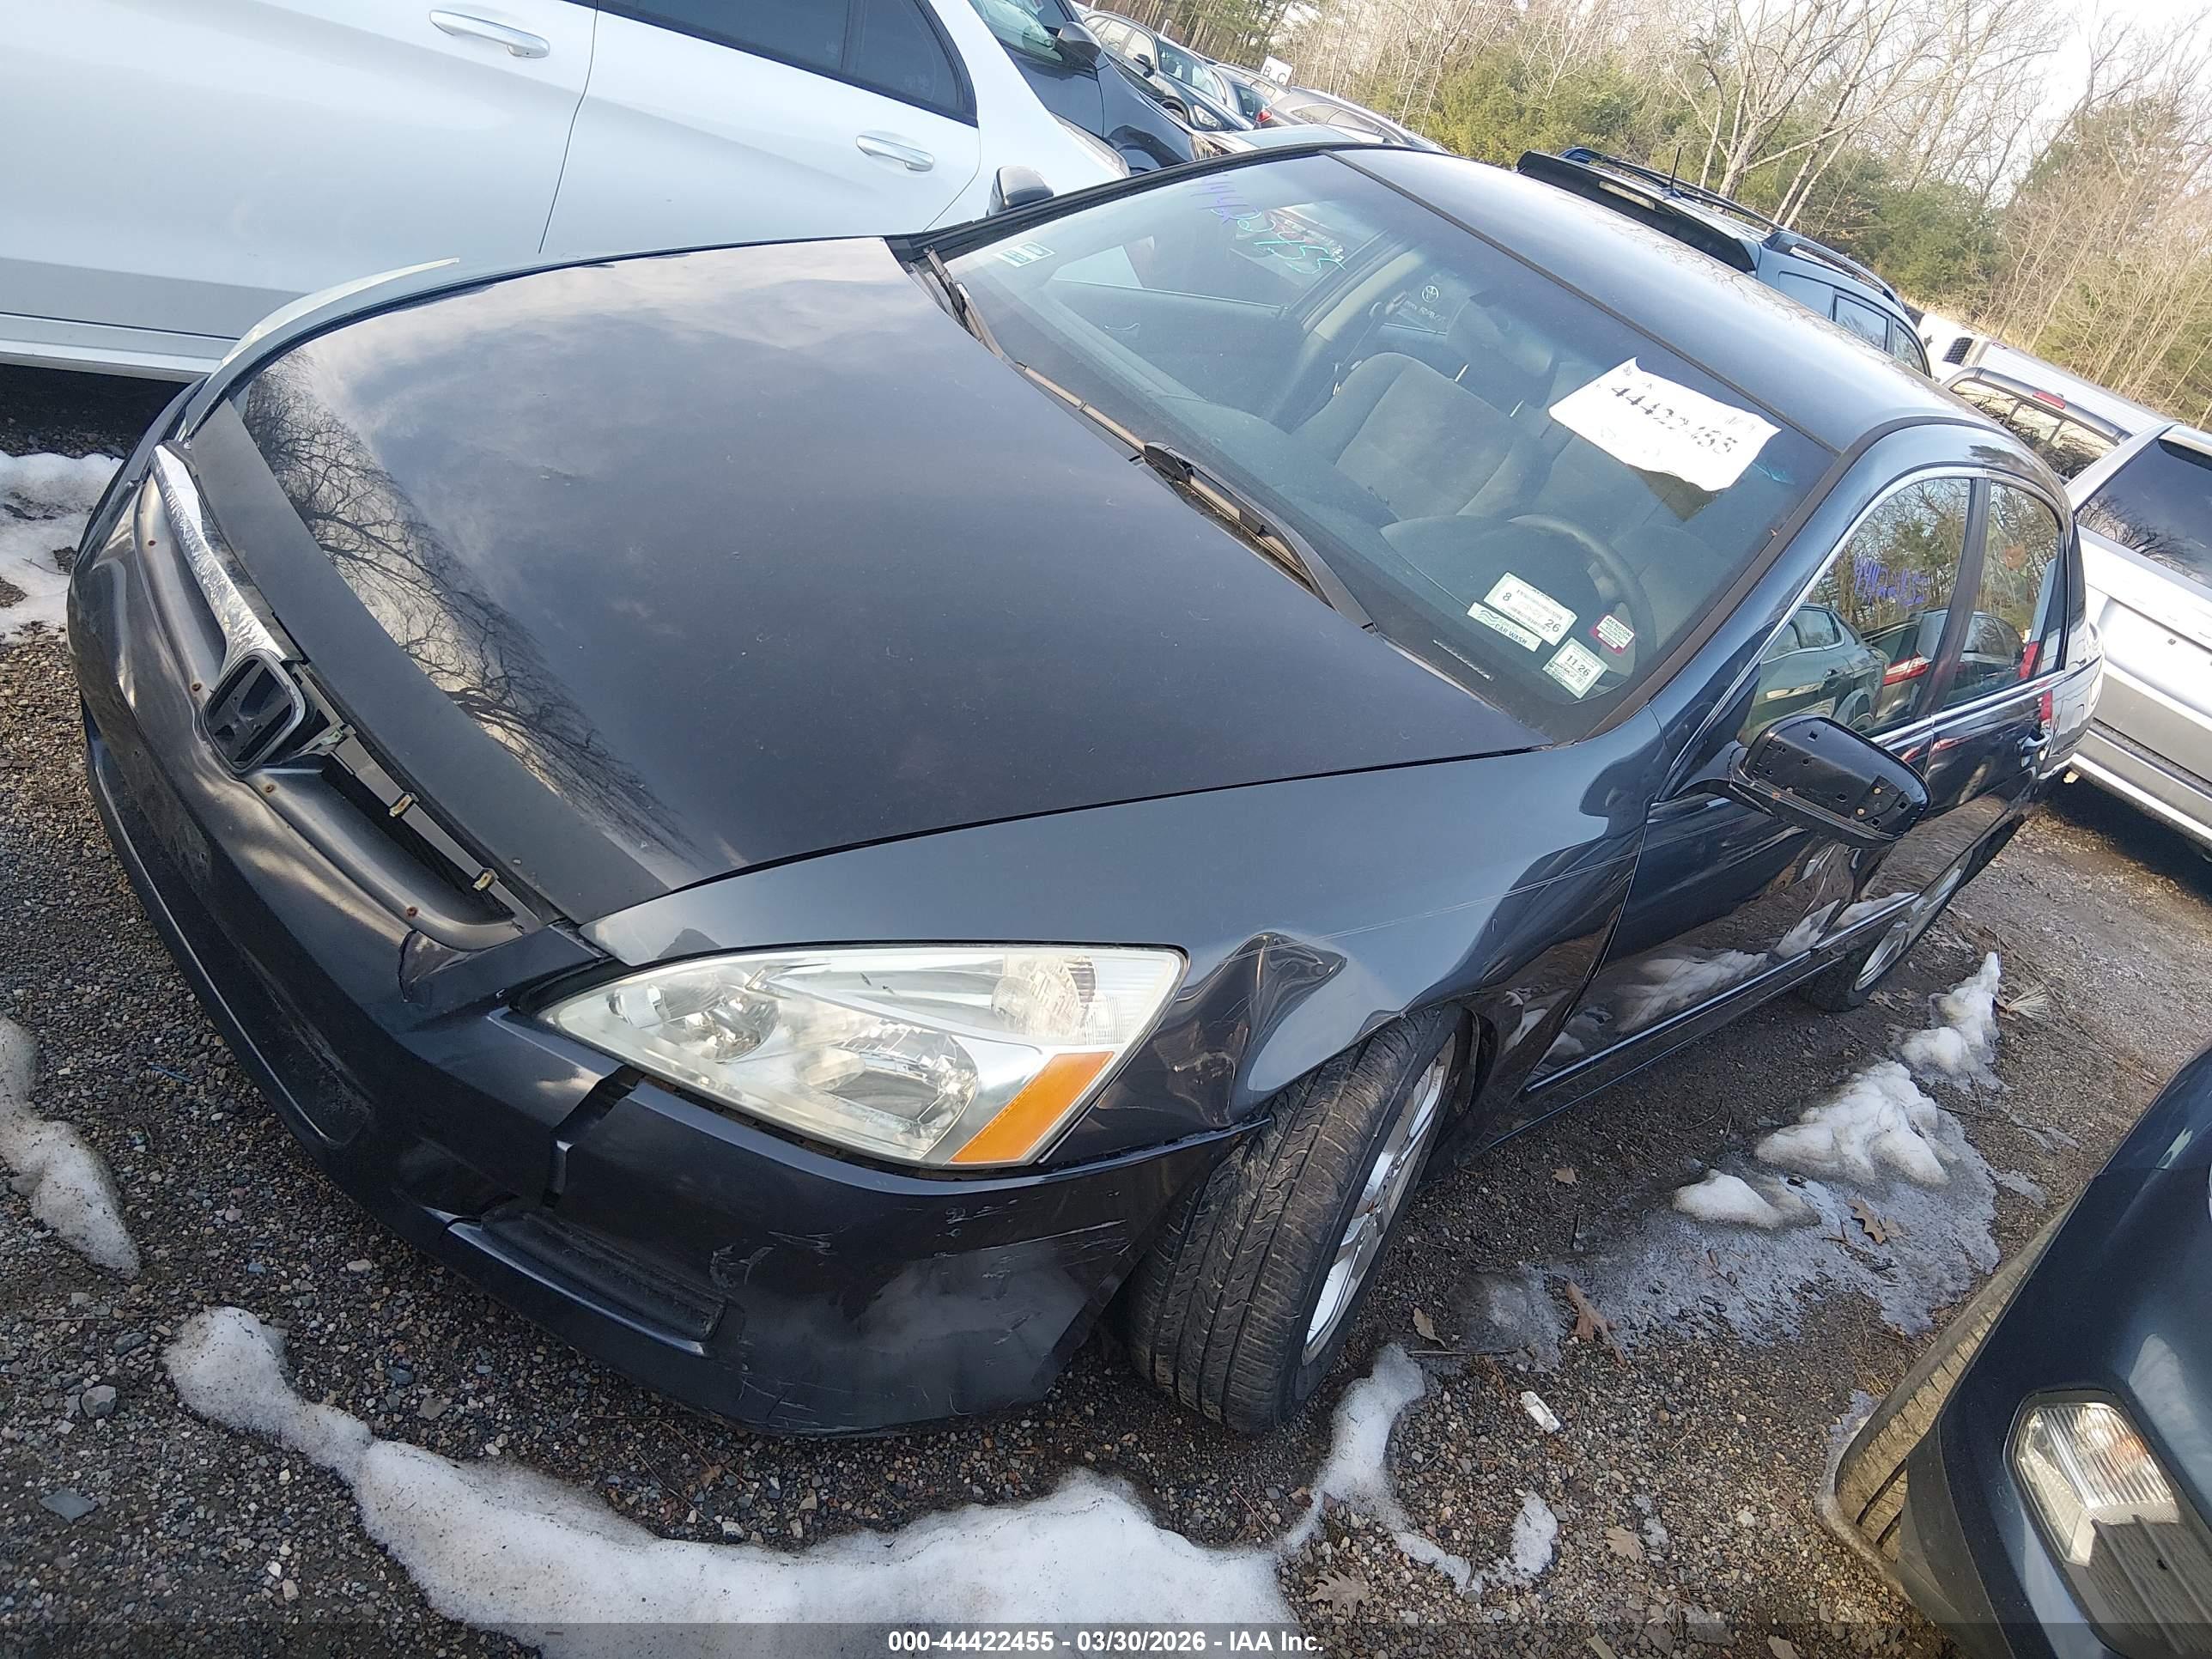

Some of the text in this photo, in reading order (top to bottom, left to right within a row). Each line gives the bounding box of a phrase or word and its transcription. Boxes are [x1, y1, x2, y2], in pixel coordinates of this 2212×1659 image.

[1263, 64, 1286, 84] B C
[1502, 592, 1512, 602] 8
[1545, 618, 1561, 633] 26
[1494, 623, 1508, 634] CAR
[1508, 630, 1528, 645] WASH
[1566, 654, 1578, 665] 11
[1578, 664, 1591, 677] 26
